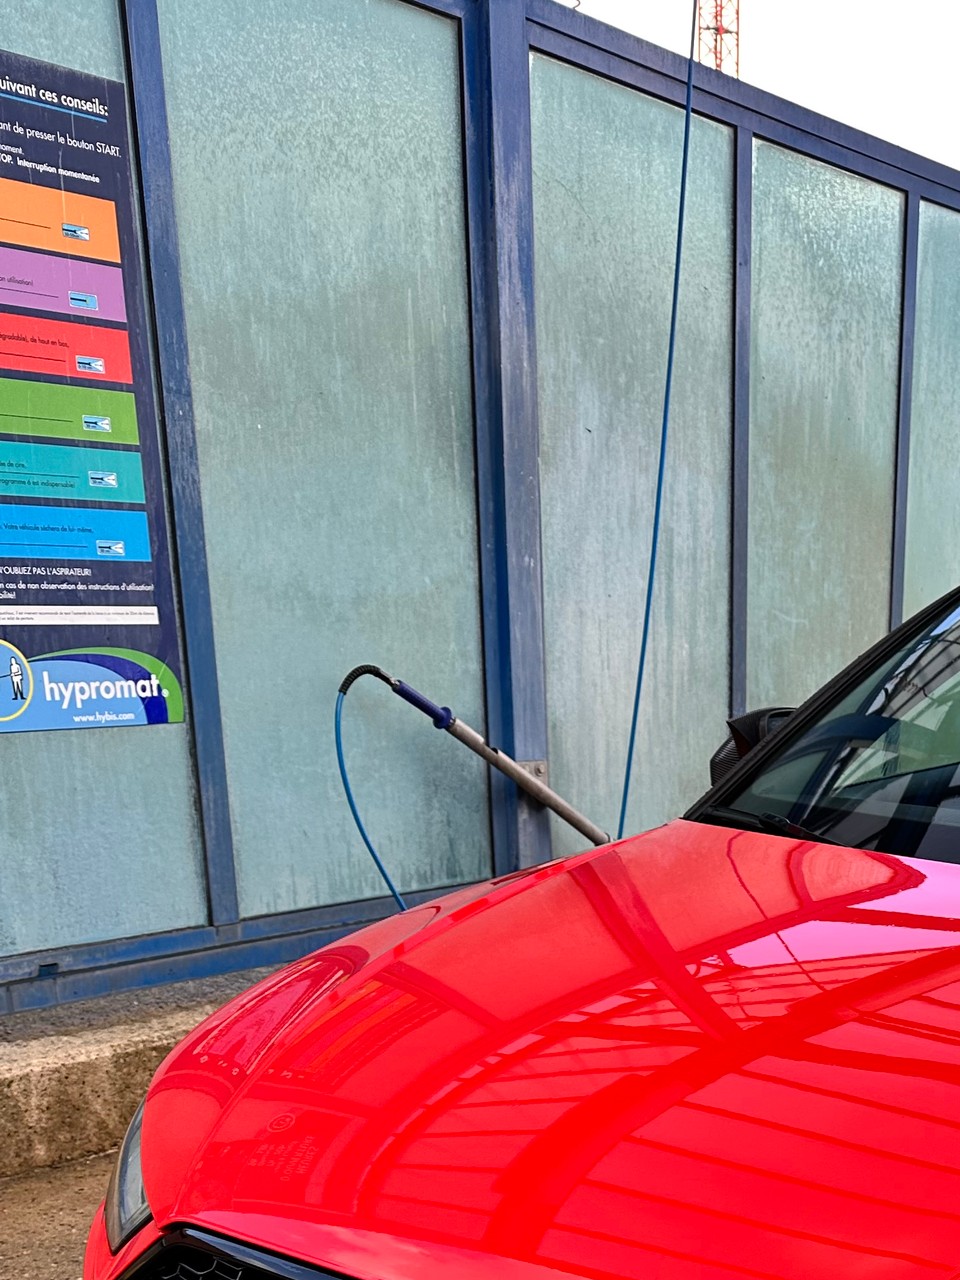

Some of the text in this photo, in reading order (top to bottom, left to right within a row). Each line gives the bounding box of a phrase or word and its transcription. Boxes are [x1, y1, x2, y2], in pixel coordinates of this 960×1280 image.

[39, 89, 58, 103] ces
[61, 95, 109, 116] conseils:
[13, 121, 25, 135] de
[26, 128, 56, 142] presser
[57, 131, 65, 144] le
[67, 134, 95, 151] bouton
[96, 142, 122, 158] START.
[17, 156, 57, 173] Interruption
[58, 167, 100, 183] momentanée
[32, 567, 46, 575] PAS
[47, 568, 92, 577] L'ASPIRATEUR!
[17, 580, 27, 589] de
[40, 581, 76, 591] observation
[77, 582, 88, 591] des
[88, 583, 120, 592] instructions
[73, 711, 135, 723] www.hybis.com
